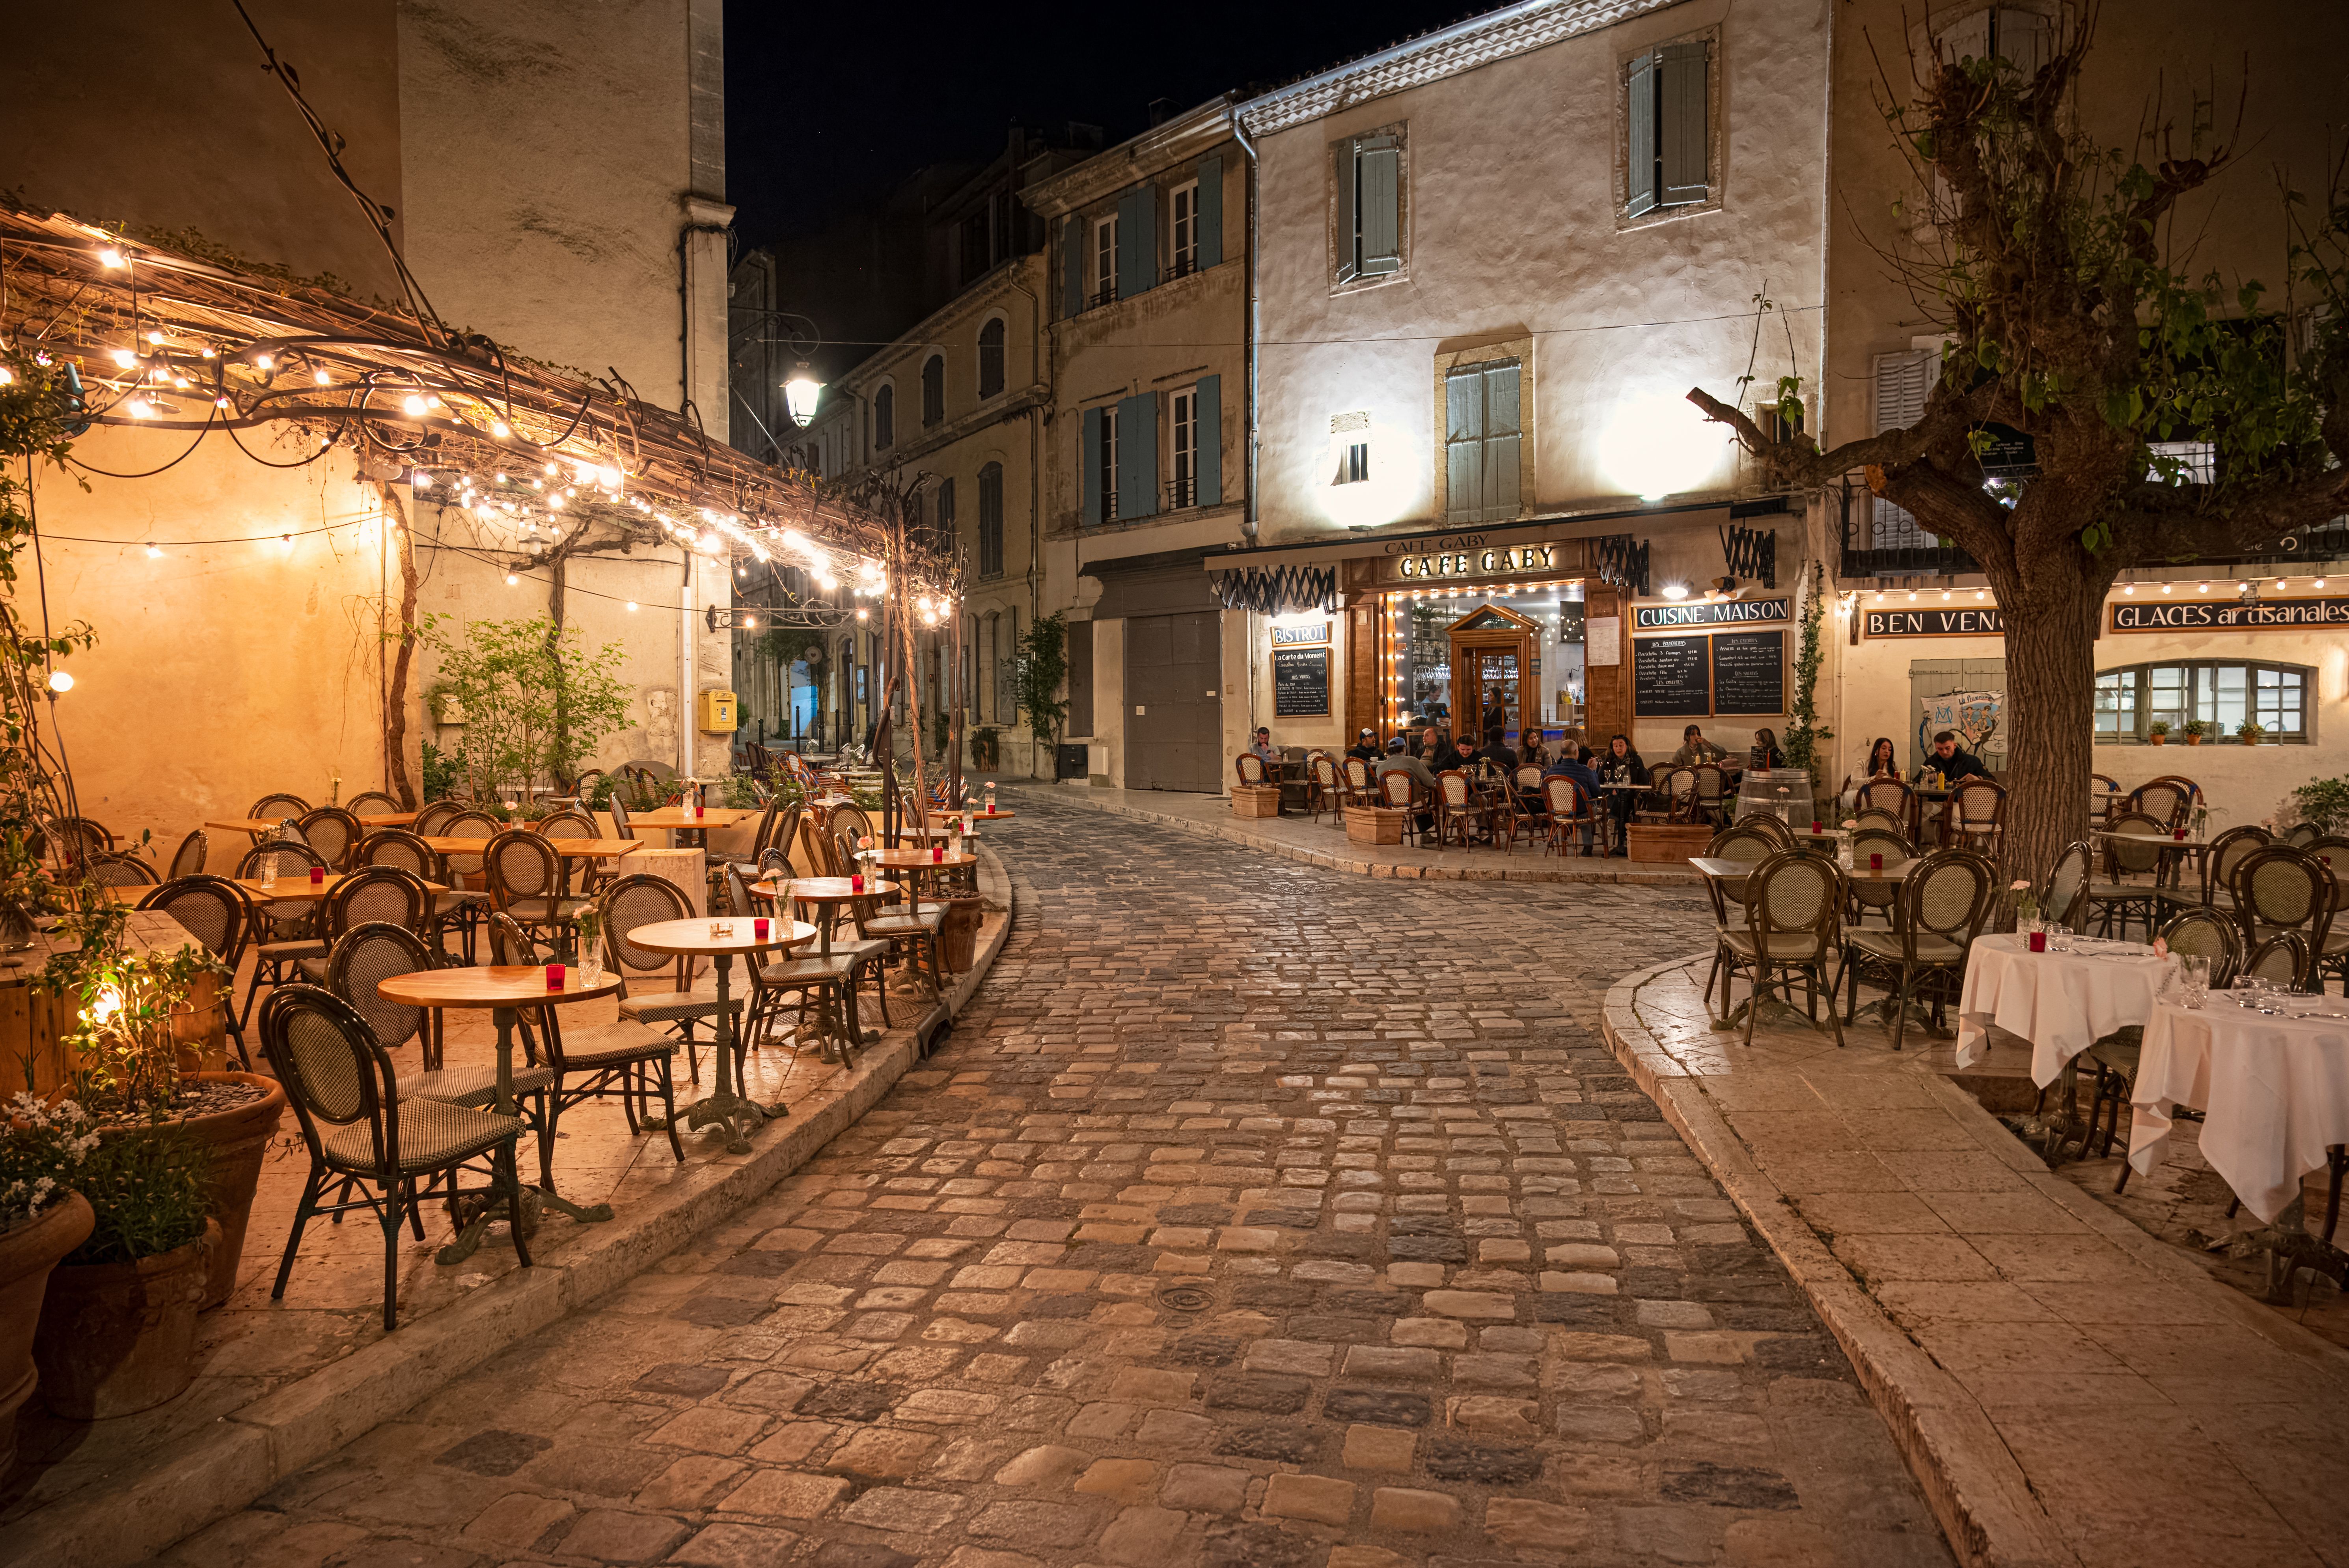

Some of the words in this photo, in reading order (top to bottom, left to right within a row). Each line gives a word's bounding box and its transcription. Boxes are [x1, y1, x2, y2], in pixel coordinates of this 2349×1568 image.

[1385, 540, 1431, 554] CAFE
[1439, 533, 1490, 549] GABY
[1400, 554, 1467, 577] CAFE
[1481, 546, 1556, 571] GABY
[1640, 606, 1704, 626] CUISINE
[1714, 601, 1786, 622] MAISON
[1870, 613, 1922, 633] BEN
[2117, 606, 2213, 627] GLACES
[1275, 625, 1326, 643] BISTROT
